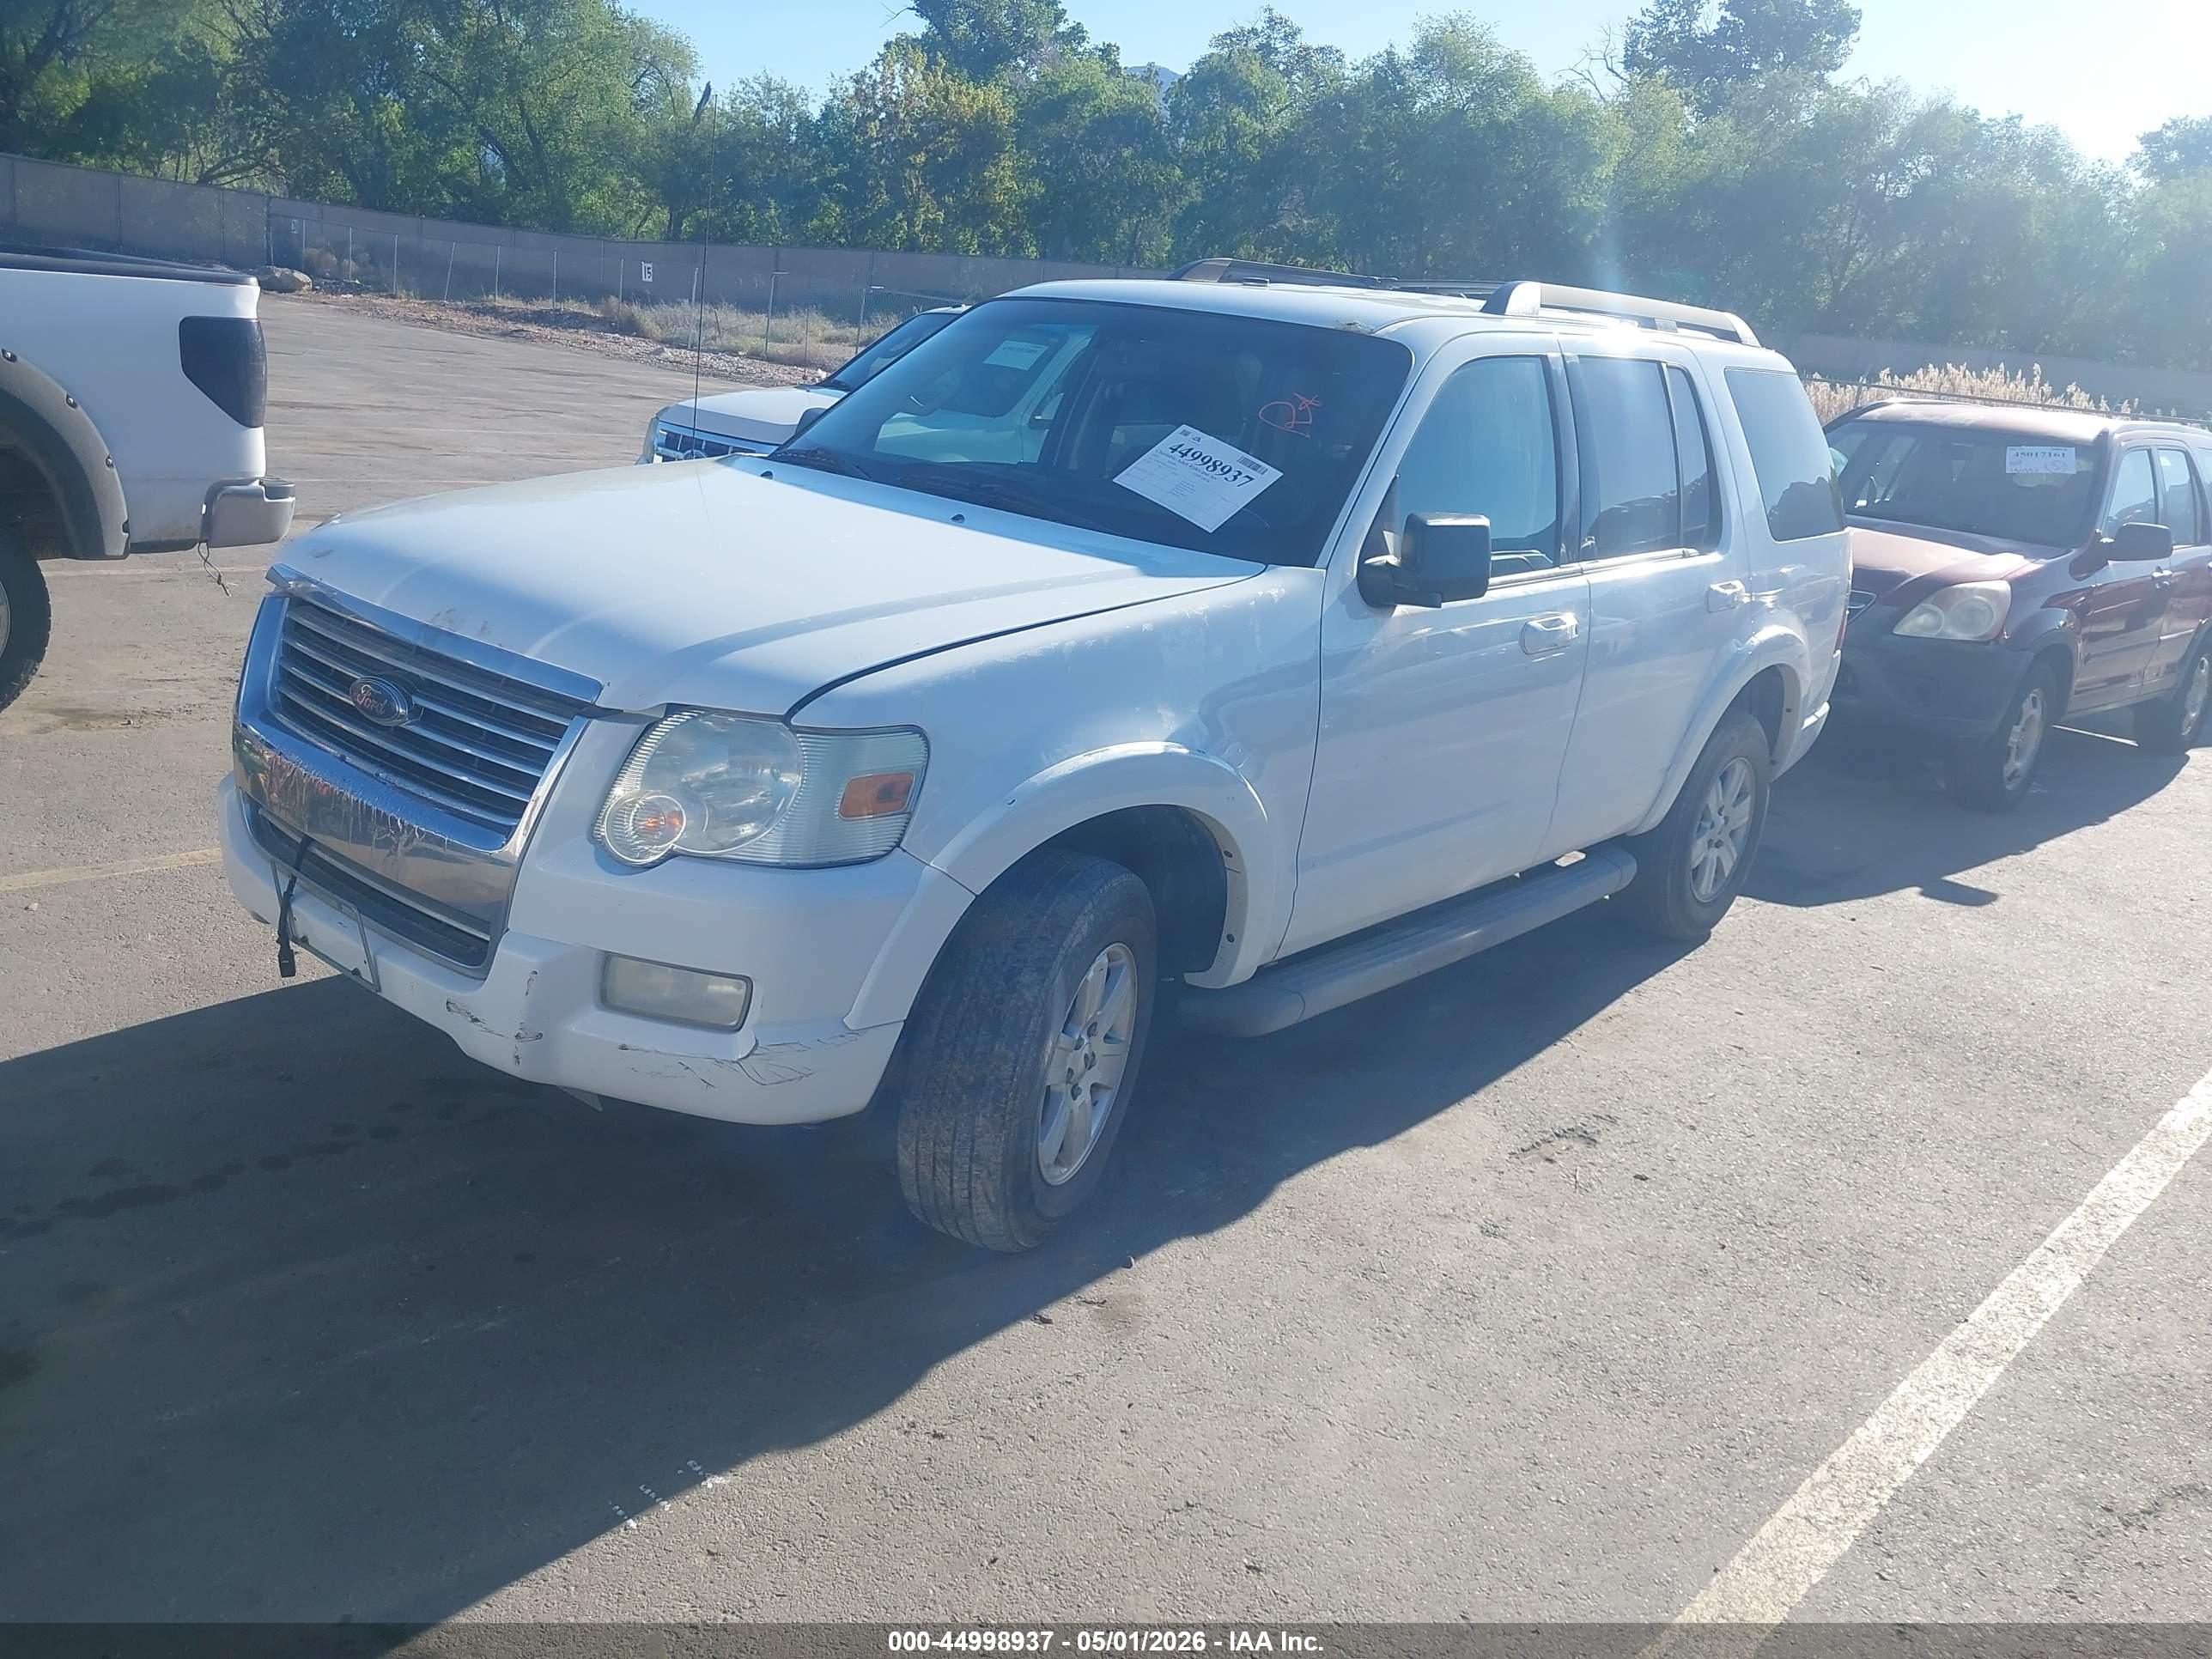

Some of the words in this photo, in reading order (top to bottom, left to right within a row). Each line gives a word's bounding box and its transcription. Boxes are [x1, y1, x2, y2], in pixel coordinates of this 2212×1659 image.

[644, 265, 652, 280] 15
[1168, 442, 1255, 488] 44998937
[356, 684, 389, 715] Ford
